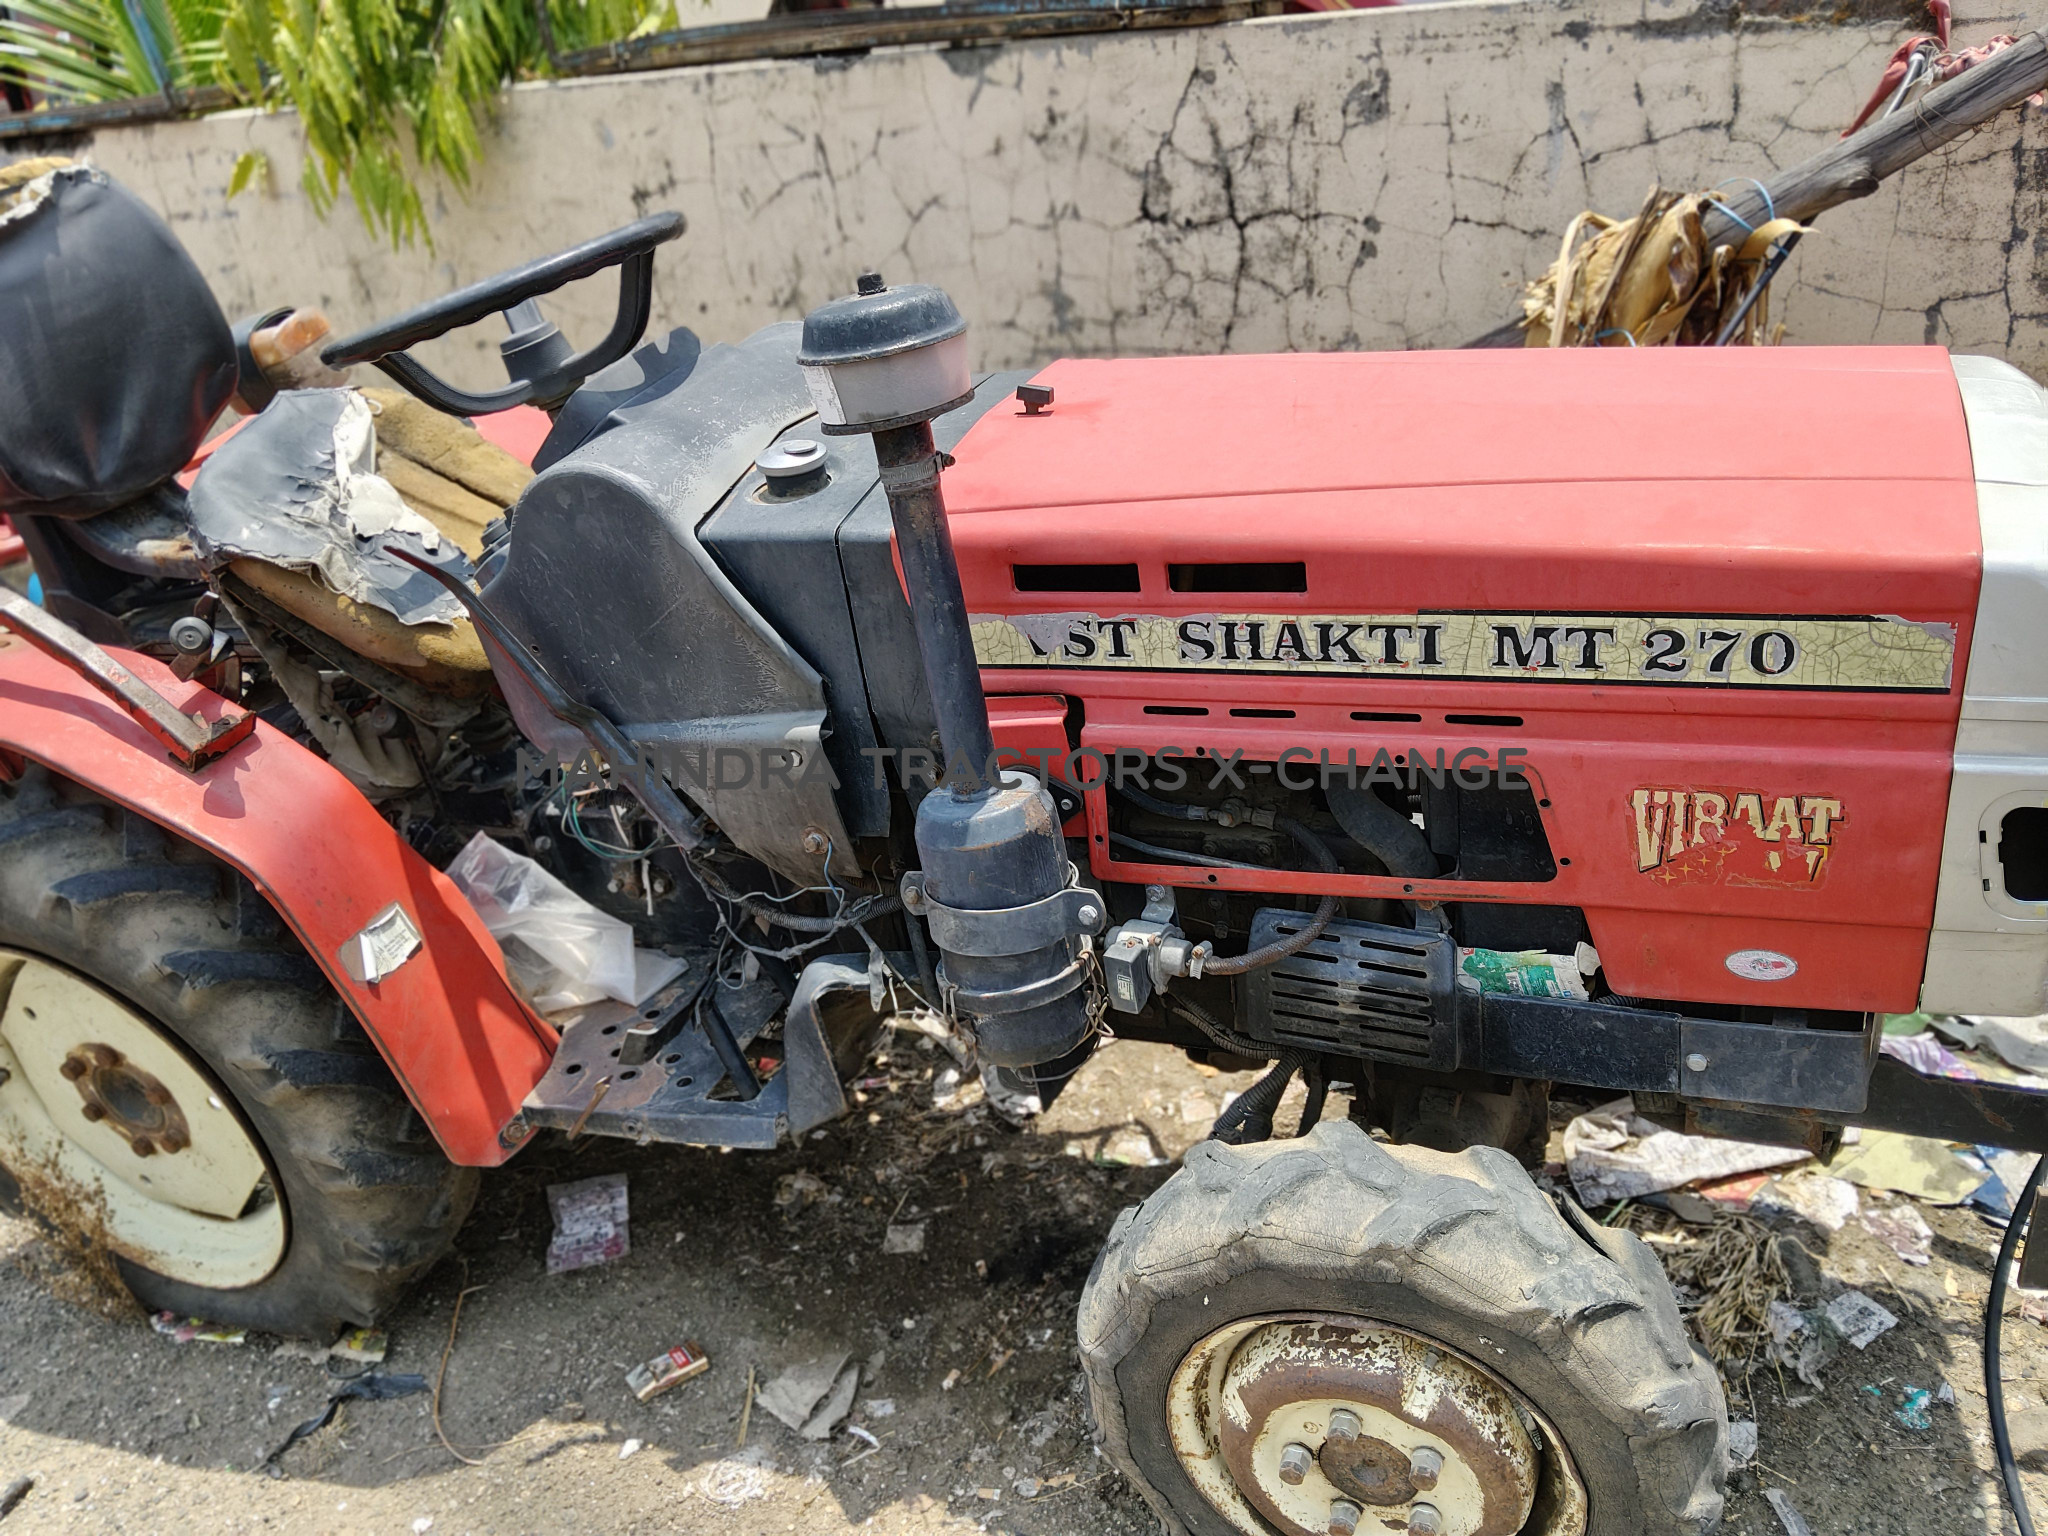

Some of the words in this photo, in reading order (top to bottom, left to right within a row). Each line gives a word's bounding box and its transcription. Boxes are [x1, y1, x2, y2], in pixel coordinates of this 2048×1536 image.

[1027, 619, 1136, 660] ST
[1178, 621, 1444, 666] SHAKTI
[1490, 625, 1616, 670] MT
[1643, 630, 1796, 675] 270
